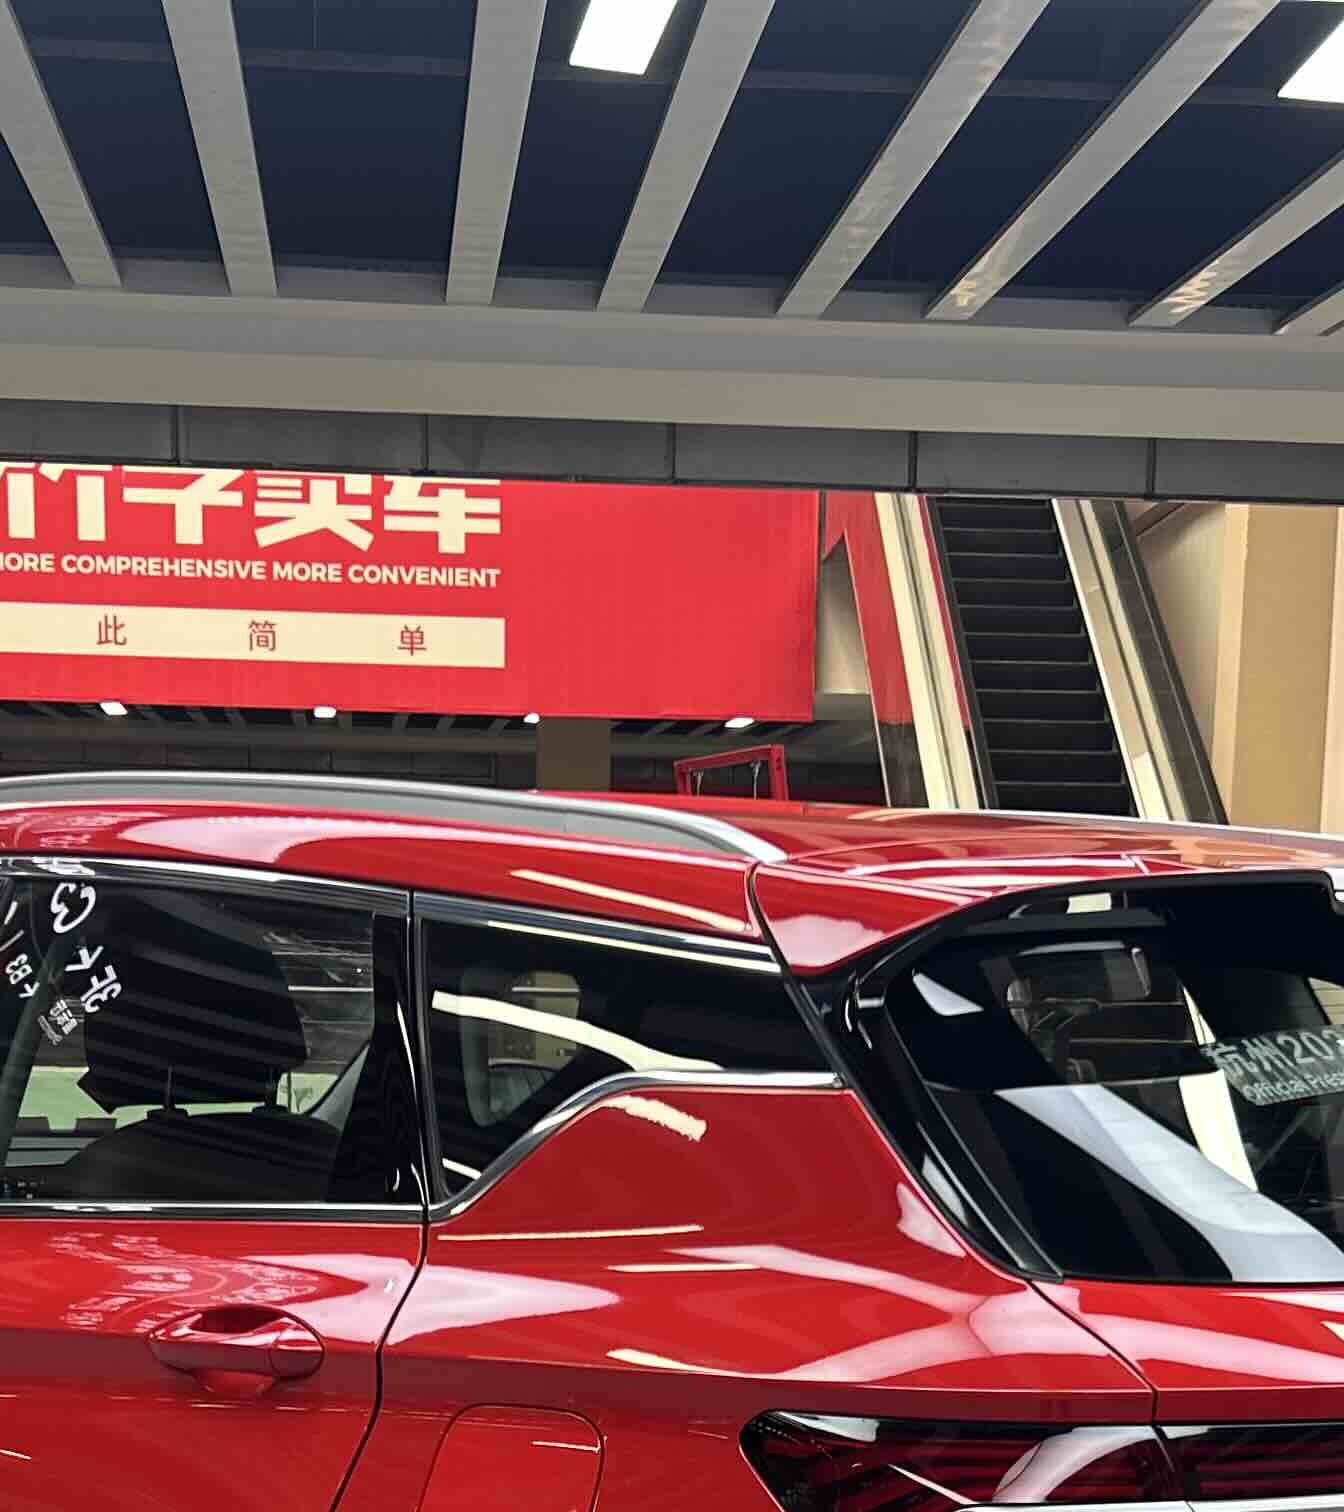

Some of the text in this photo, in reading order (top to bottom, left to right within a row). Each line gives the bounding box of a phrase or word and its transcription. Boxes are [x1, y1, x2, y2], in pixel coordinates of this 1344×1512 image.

[61, 554, 267, 582] COMPREHENSIVE
[272, 560, 343, 585] MORE
[348, 563, 501, 588] CONVENIENT
